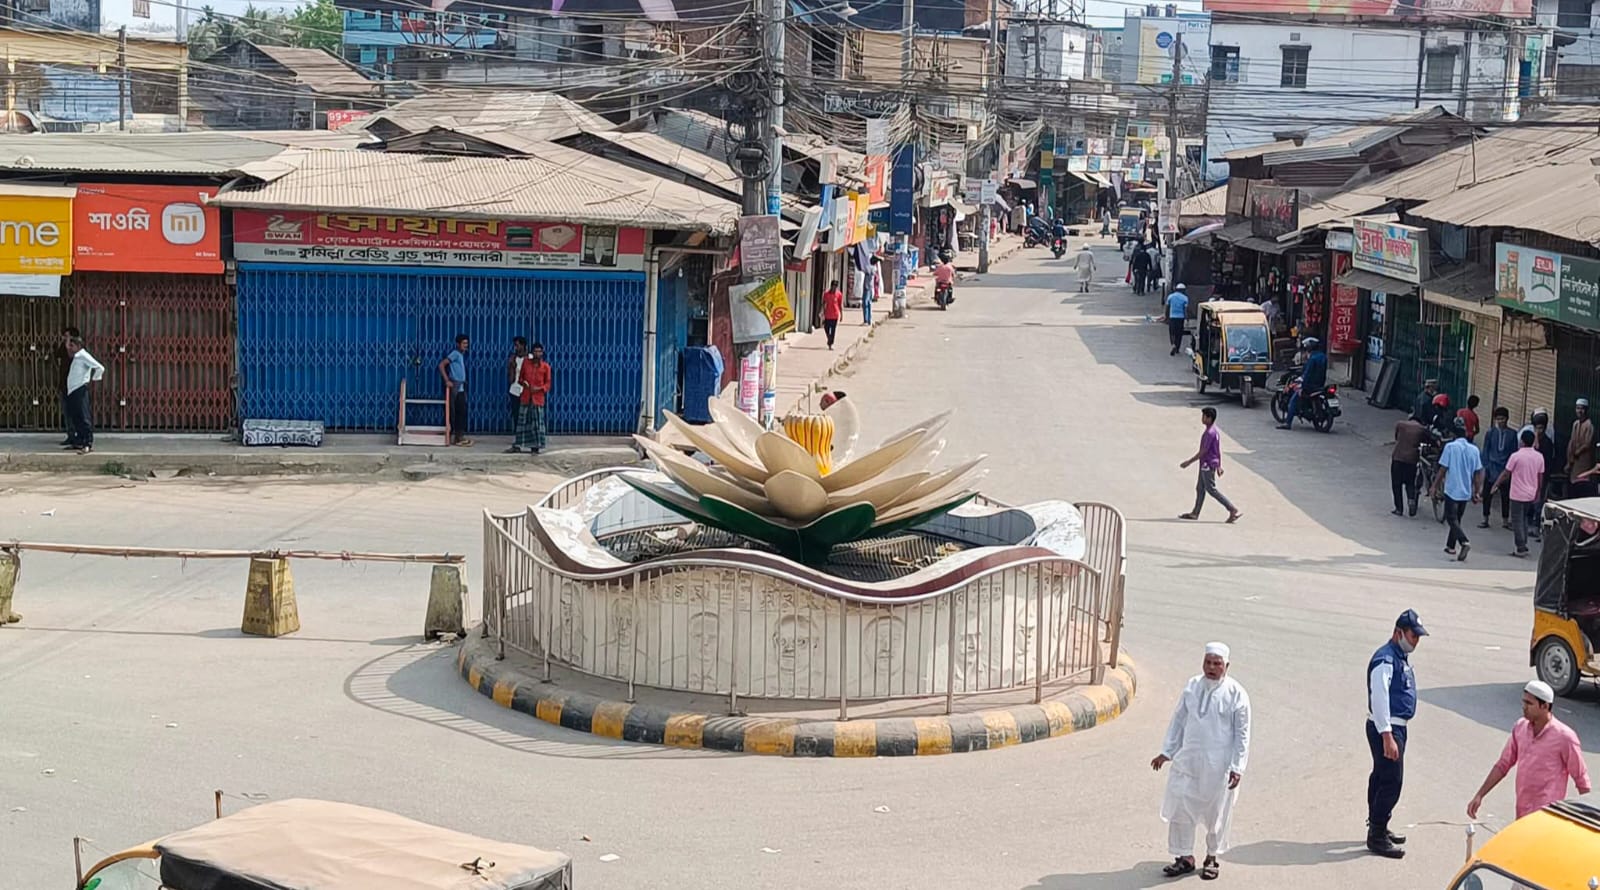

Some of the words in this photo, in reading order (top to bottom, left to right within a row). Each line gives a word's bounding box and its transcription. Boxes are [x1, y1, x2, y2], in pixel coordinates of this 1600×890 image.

[88, 207, 150, 231] শাওমি
[266, 232, 301, 240] SWAN
[298, 246, 345, 260] কুমিল্লা
[349, 248, 389, 261] বেডিং
[423, 249, 448, 261] পর্দা
[453, 250, 503, 263] গ্যালারী
